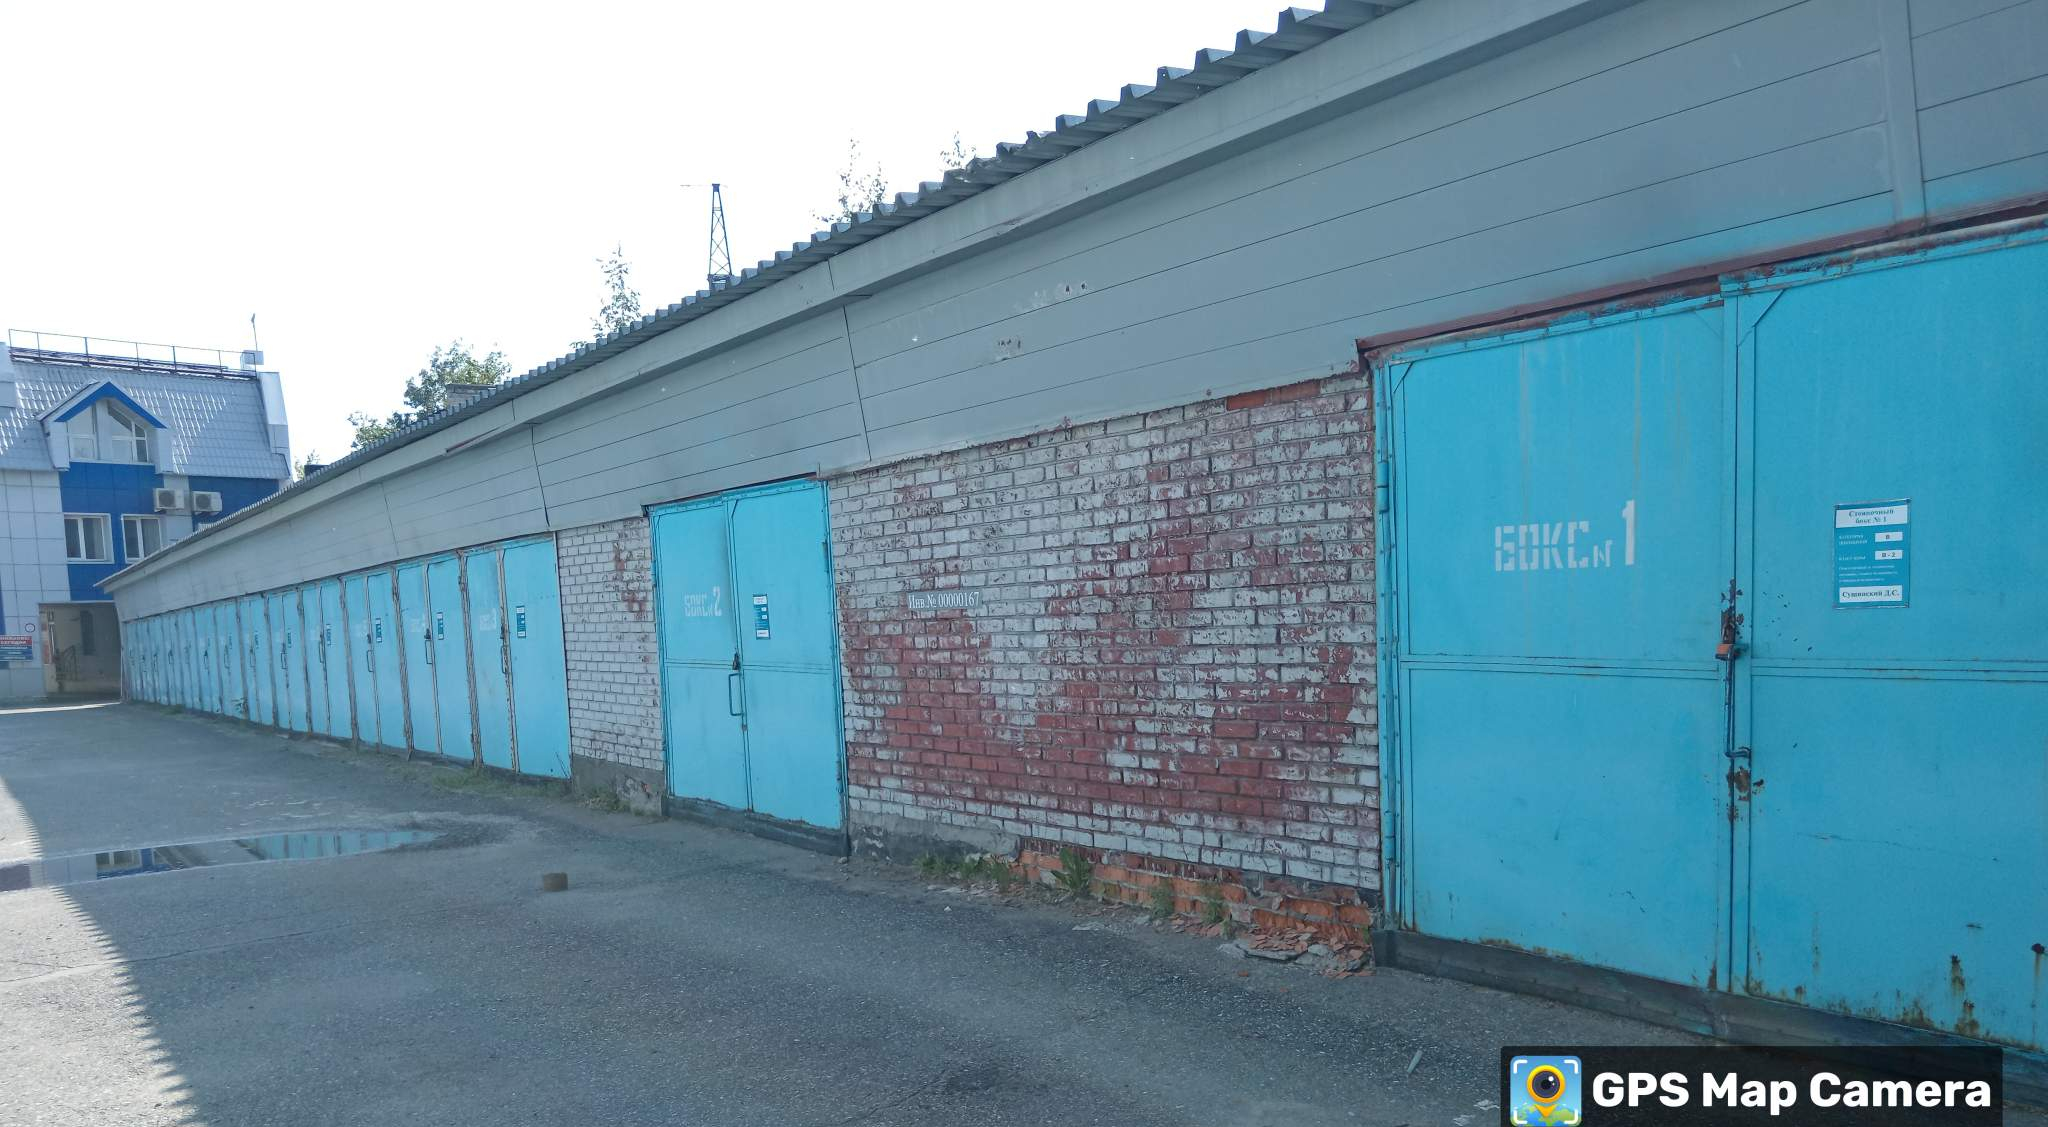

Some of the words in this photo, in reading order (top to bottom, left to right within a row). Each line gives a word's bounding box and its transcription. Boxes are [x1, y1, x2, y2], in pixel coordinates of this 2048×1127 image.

[1495, 521, 1590, 572] БОКС
[1622, 499, 1636, 566] 1
[938, 591, 980, 607] 00000167
